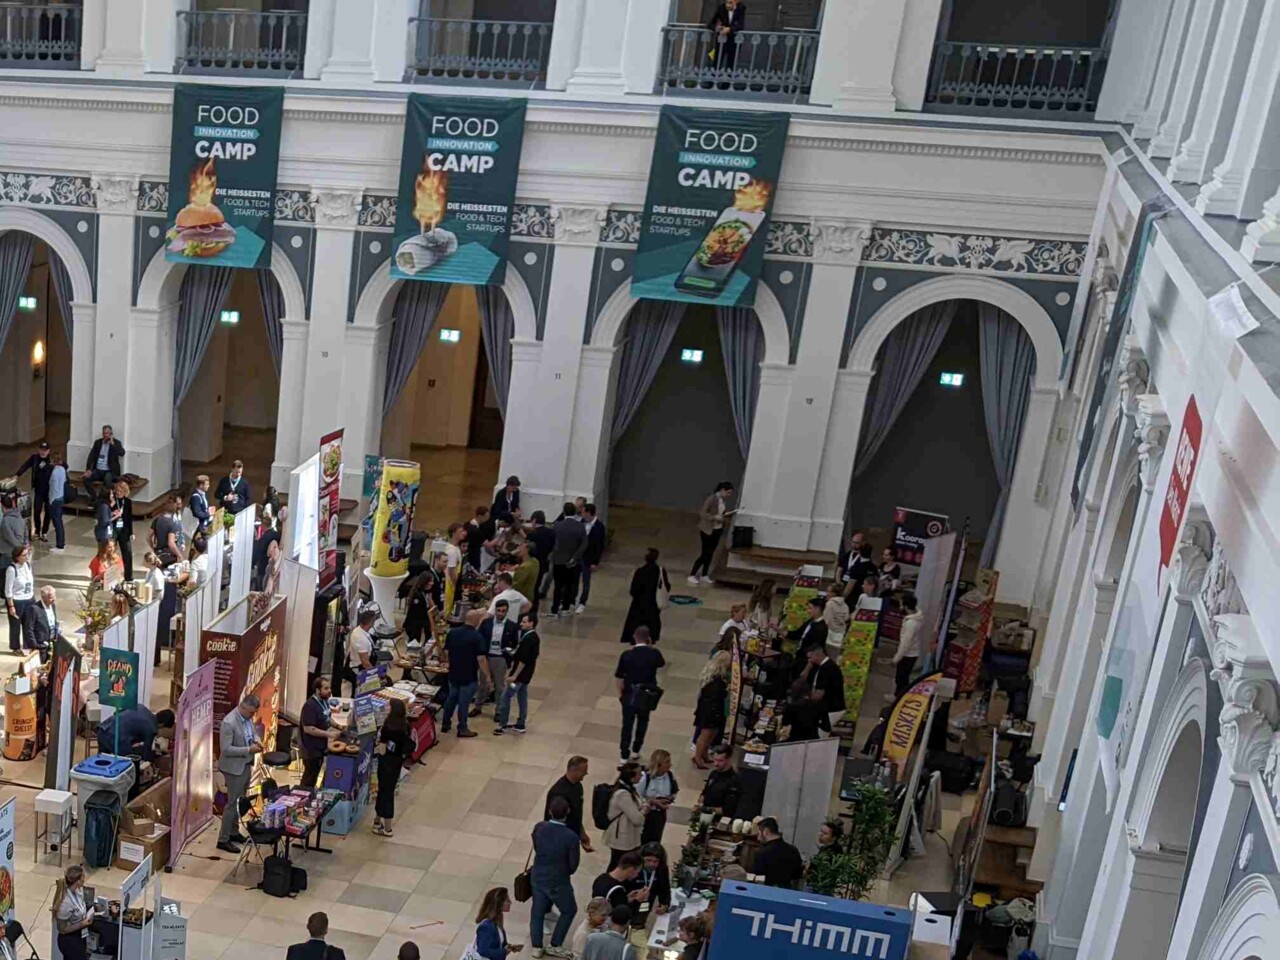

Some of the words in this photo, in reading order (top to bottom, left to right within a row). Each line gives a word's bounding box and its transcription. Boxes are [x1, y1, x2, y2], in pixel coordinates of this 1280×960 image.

[197, 105, 259, 125] FOOD
[199, 127, 254, 138] INNOVATION
[432, 116, 499, 137] FOOD
[432, 138, 492, 150] INNOVATION
[684, 129, 757, 152] FOOD
[195, 140, 257, 160] CAMP
[428, 152, 494, 173] CAMP
[684, 153, 751, 166] INNOVATION
[677, 167, 751, 190] CAMP
[228, 188, 271, 198] HEISSESTEN
[224, 198, 243, 206] FOOD
[251, 199, 270, 208] TECH
[447, 202, 459, 210] DIE
[461, 203, 508, 213] HEISSESTEN
[233, 208, 270, 217] STARTUPS
[652, 205, 666, 213] DIE
[667, 206, 718, 217] HEISSESTEN
[455, 213, 478, 221] FOOD
[486, 214, 507, 223] TECH
[651, 215, 674, 224] FOOD
[683, 217, 706, 227] TECH
[466, 223, 506, 233] STARTUPS
[650, 225, 692, 236] STARTUPS
[207, 638, 237, 651] cookie
[192, 700, 212, 722] HEMP
[890, 699, 922, 748] MISKETS
